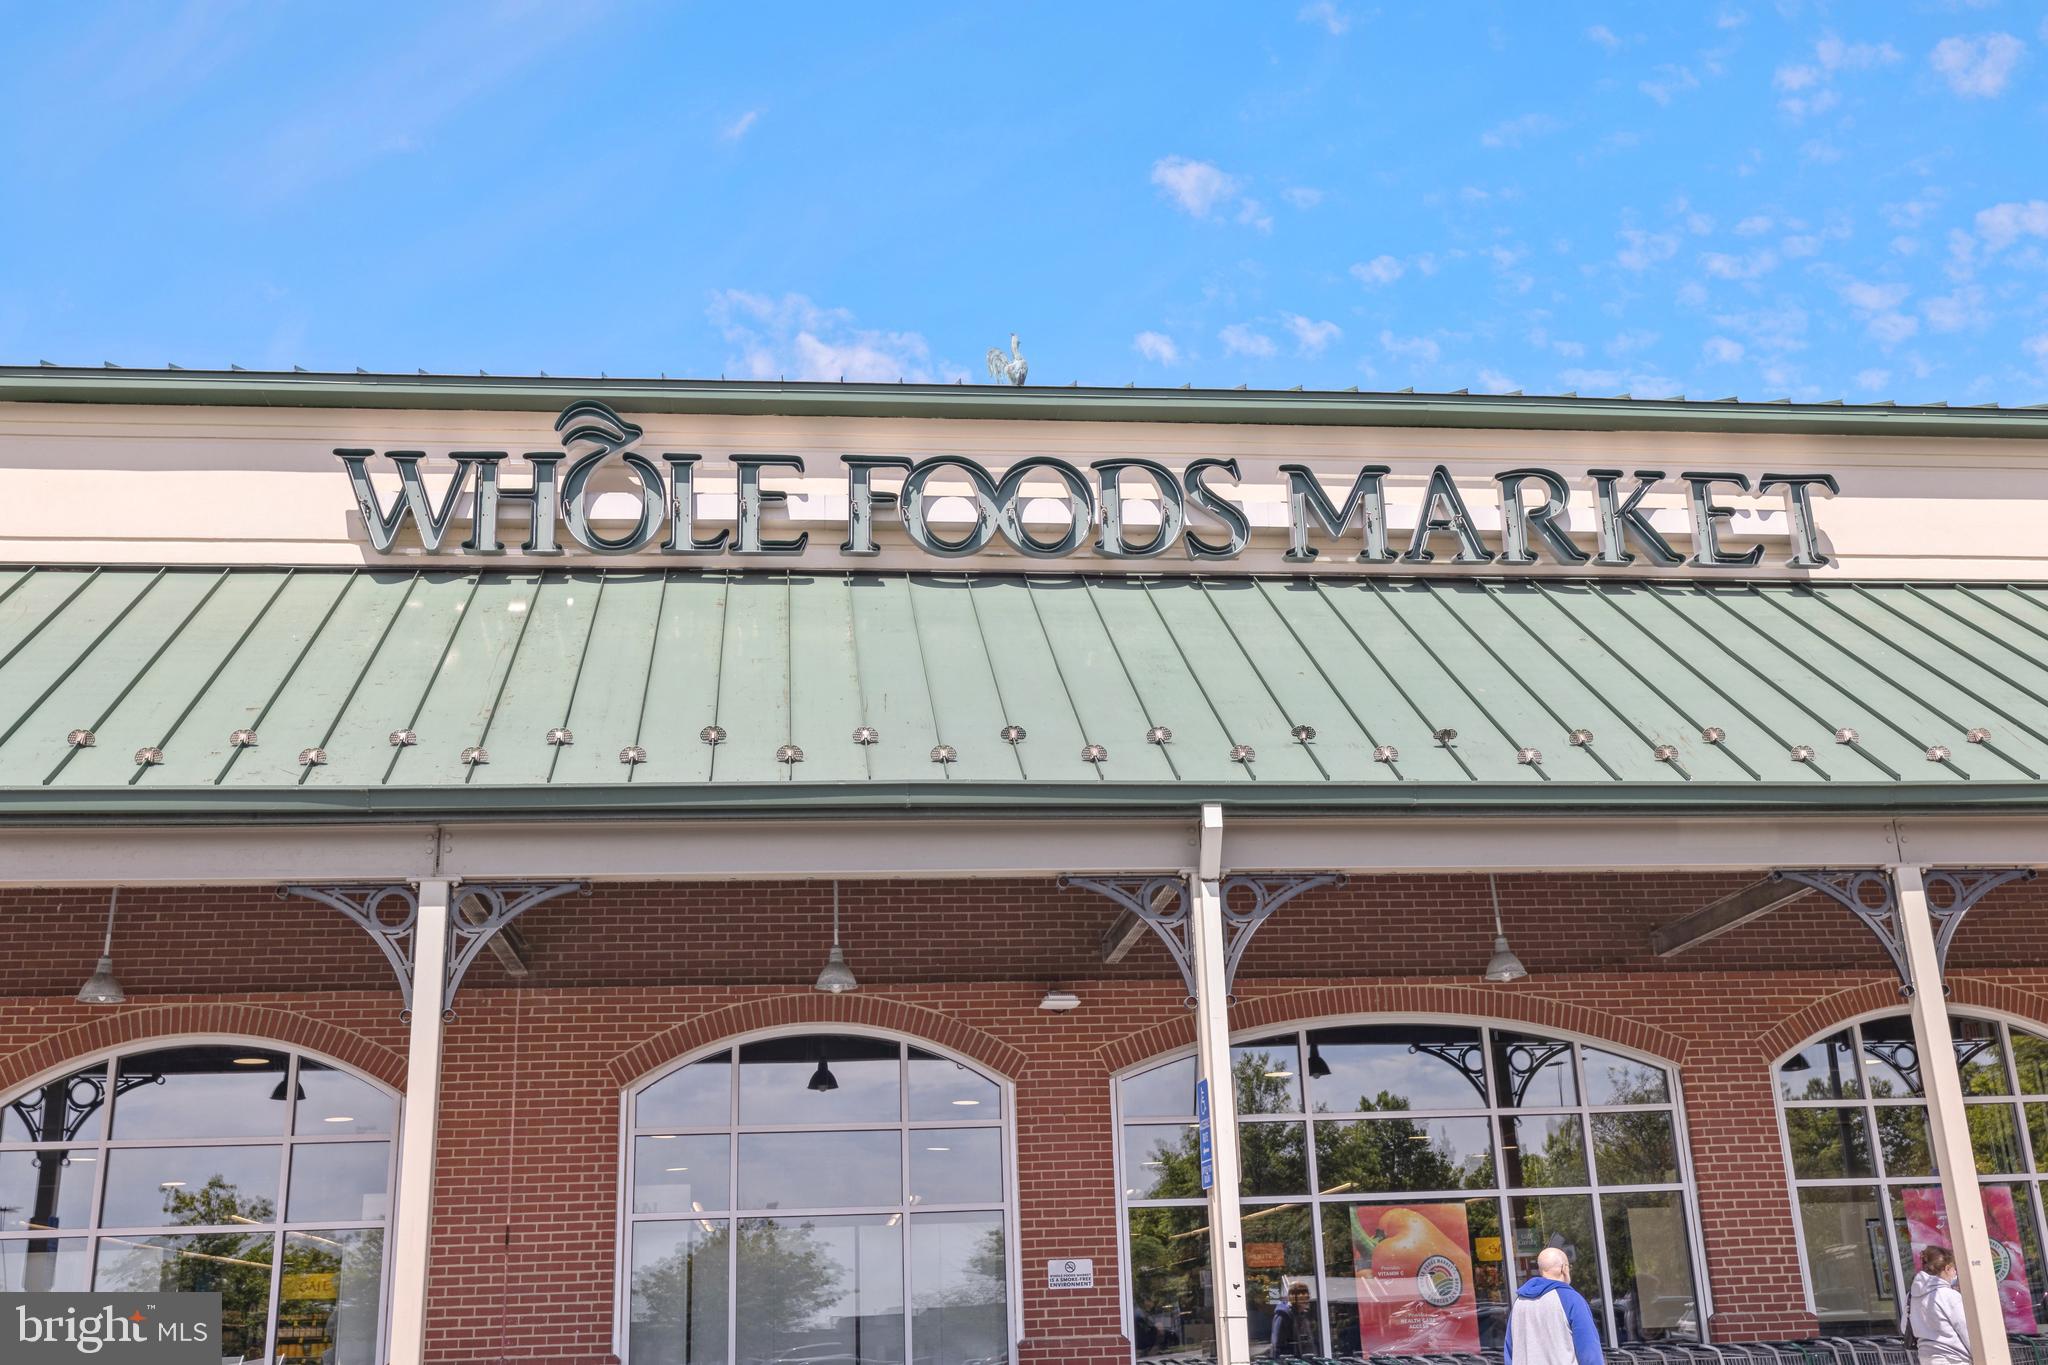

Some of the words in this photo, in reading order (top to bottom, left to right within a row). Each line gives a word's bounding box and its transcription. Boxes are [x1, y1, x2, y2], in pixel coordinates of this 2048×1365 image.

[332, 401, 808, 556] WHOLE
[840, 455, 1251, 561] FOODS
[1277, 464, 1841, 569] MARKET
